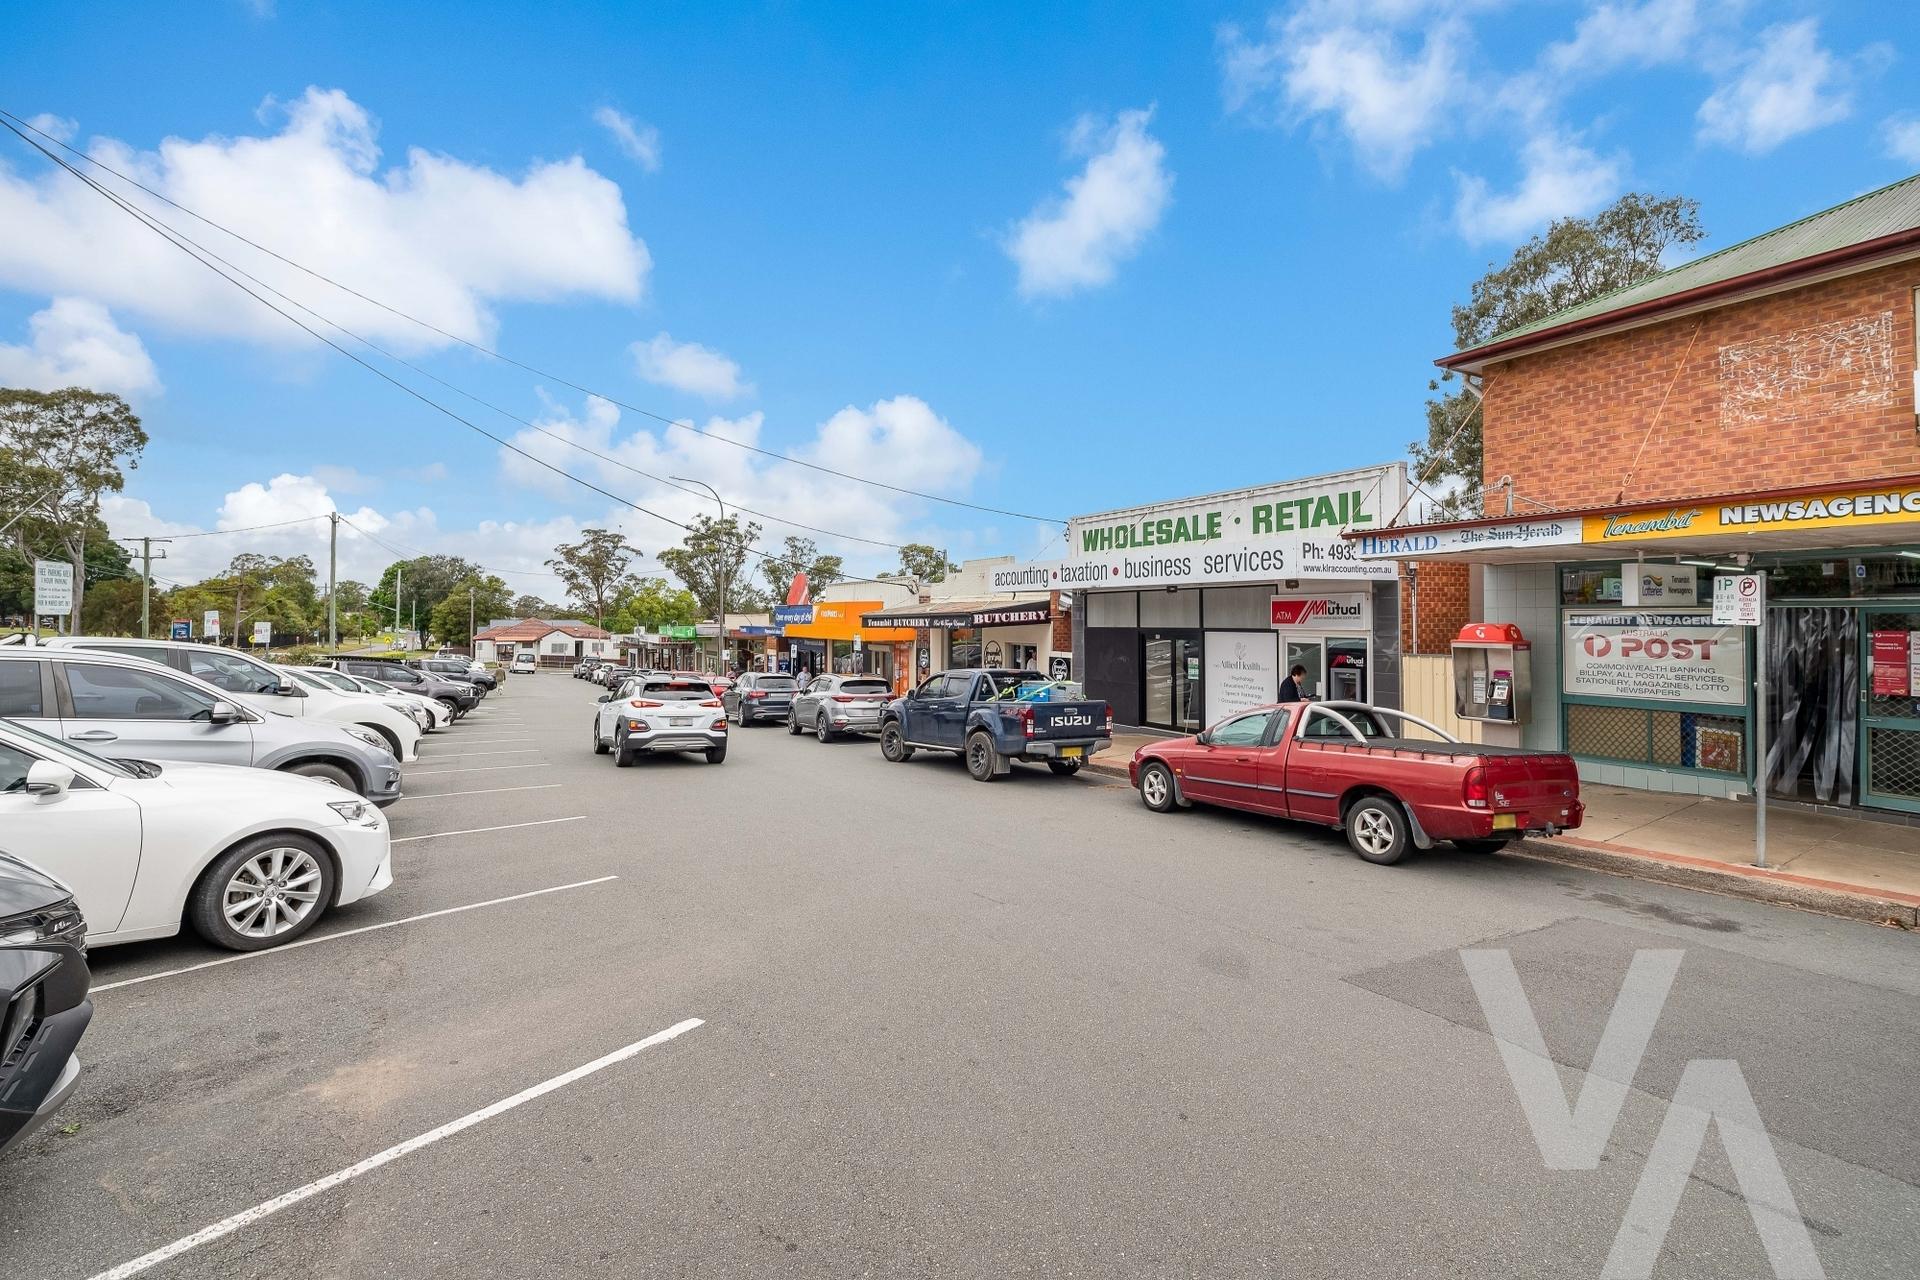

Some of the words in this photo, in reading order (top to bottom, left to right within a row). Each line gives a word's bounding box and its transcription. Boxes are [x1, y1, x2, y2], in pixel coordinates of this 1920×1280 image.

[1602, 509, 1703, 538] Tenambit
[1719, 491, 1920, 526] NEWSAGENC
[1082, 511, 1222, 552] WHOLESALE
[1252, 490, 1373, 535] RETAIL
[1460, 529, 1484, 544] The
[1302, 542, 1324, 559] Ph:
[1361, 535, 1438, 555] HERALD
[994, 566, 1049, 587] accounting
[1060, 561, 1108, 582] taxation
[1124, 555, 1191, 579] business
[1203, 547, 1284, 574] services
[1718, 579, 1733, 590] 1P
[1642, 586, 1663, 596] Lotteries
[1668, 586, 1693, 596] Newsagency
[1310, 600, 1361, 615] Mutual
[973, 610, 1048, 625] BUTCHERY
[1275, 611, 1292, 620] ATM
[1572, 615, 1632, 625] TENAMBIT
[1636, 615, 1713, 625] NEWSAGEN
[867, 618, 892, 627] Tenambit
[893, 618, 930, 627] BUTCHERY
[1621, 629, 1669, 637] AUSTRALIA
[1621, 638, 1718, 660] POST
[1586, 662, 1667, 672] COMMONWEALTH
[1670, 666, 1716, 674] BANKING
[1635, 672, 1672, 680] POSTAL
[1674, 674, 1725, 683] SERVICES
[1616, 686, 1681, 696] NEWSPAPERS
[1695, 684, 1730, 692] LOTTO
[1050, 715, 1091, 727] ISUZU
